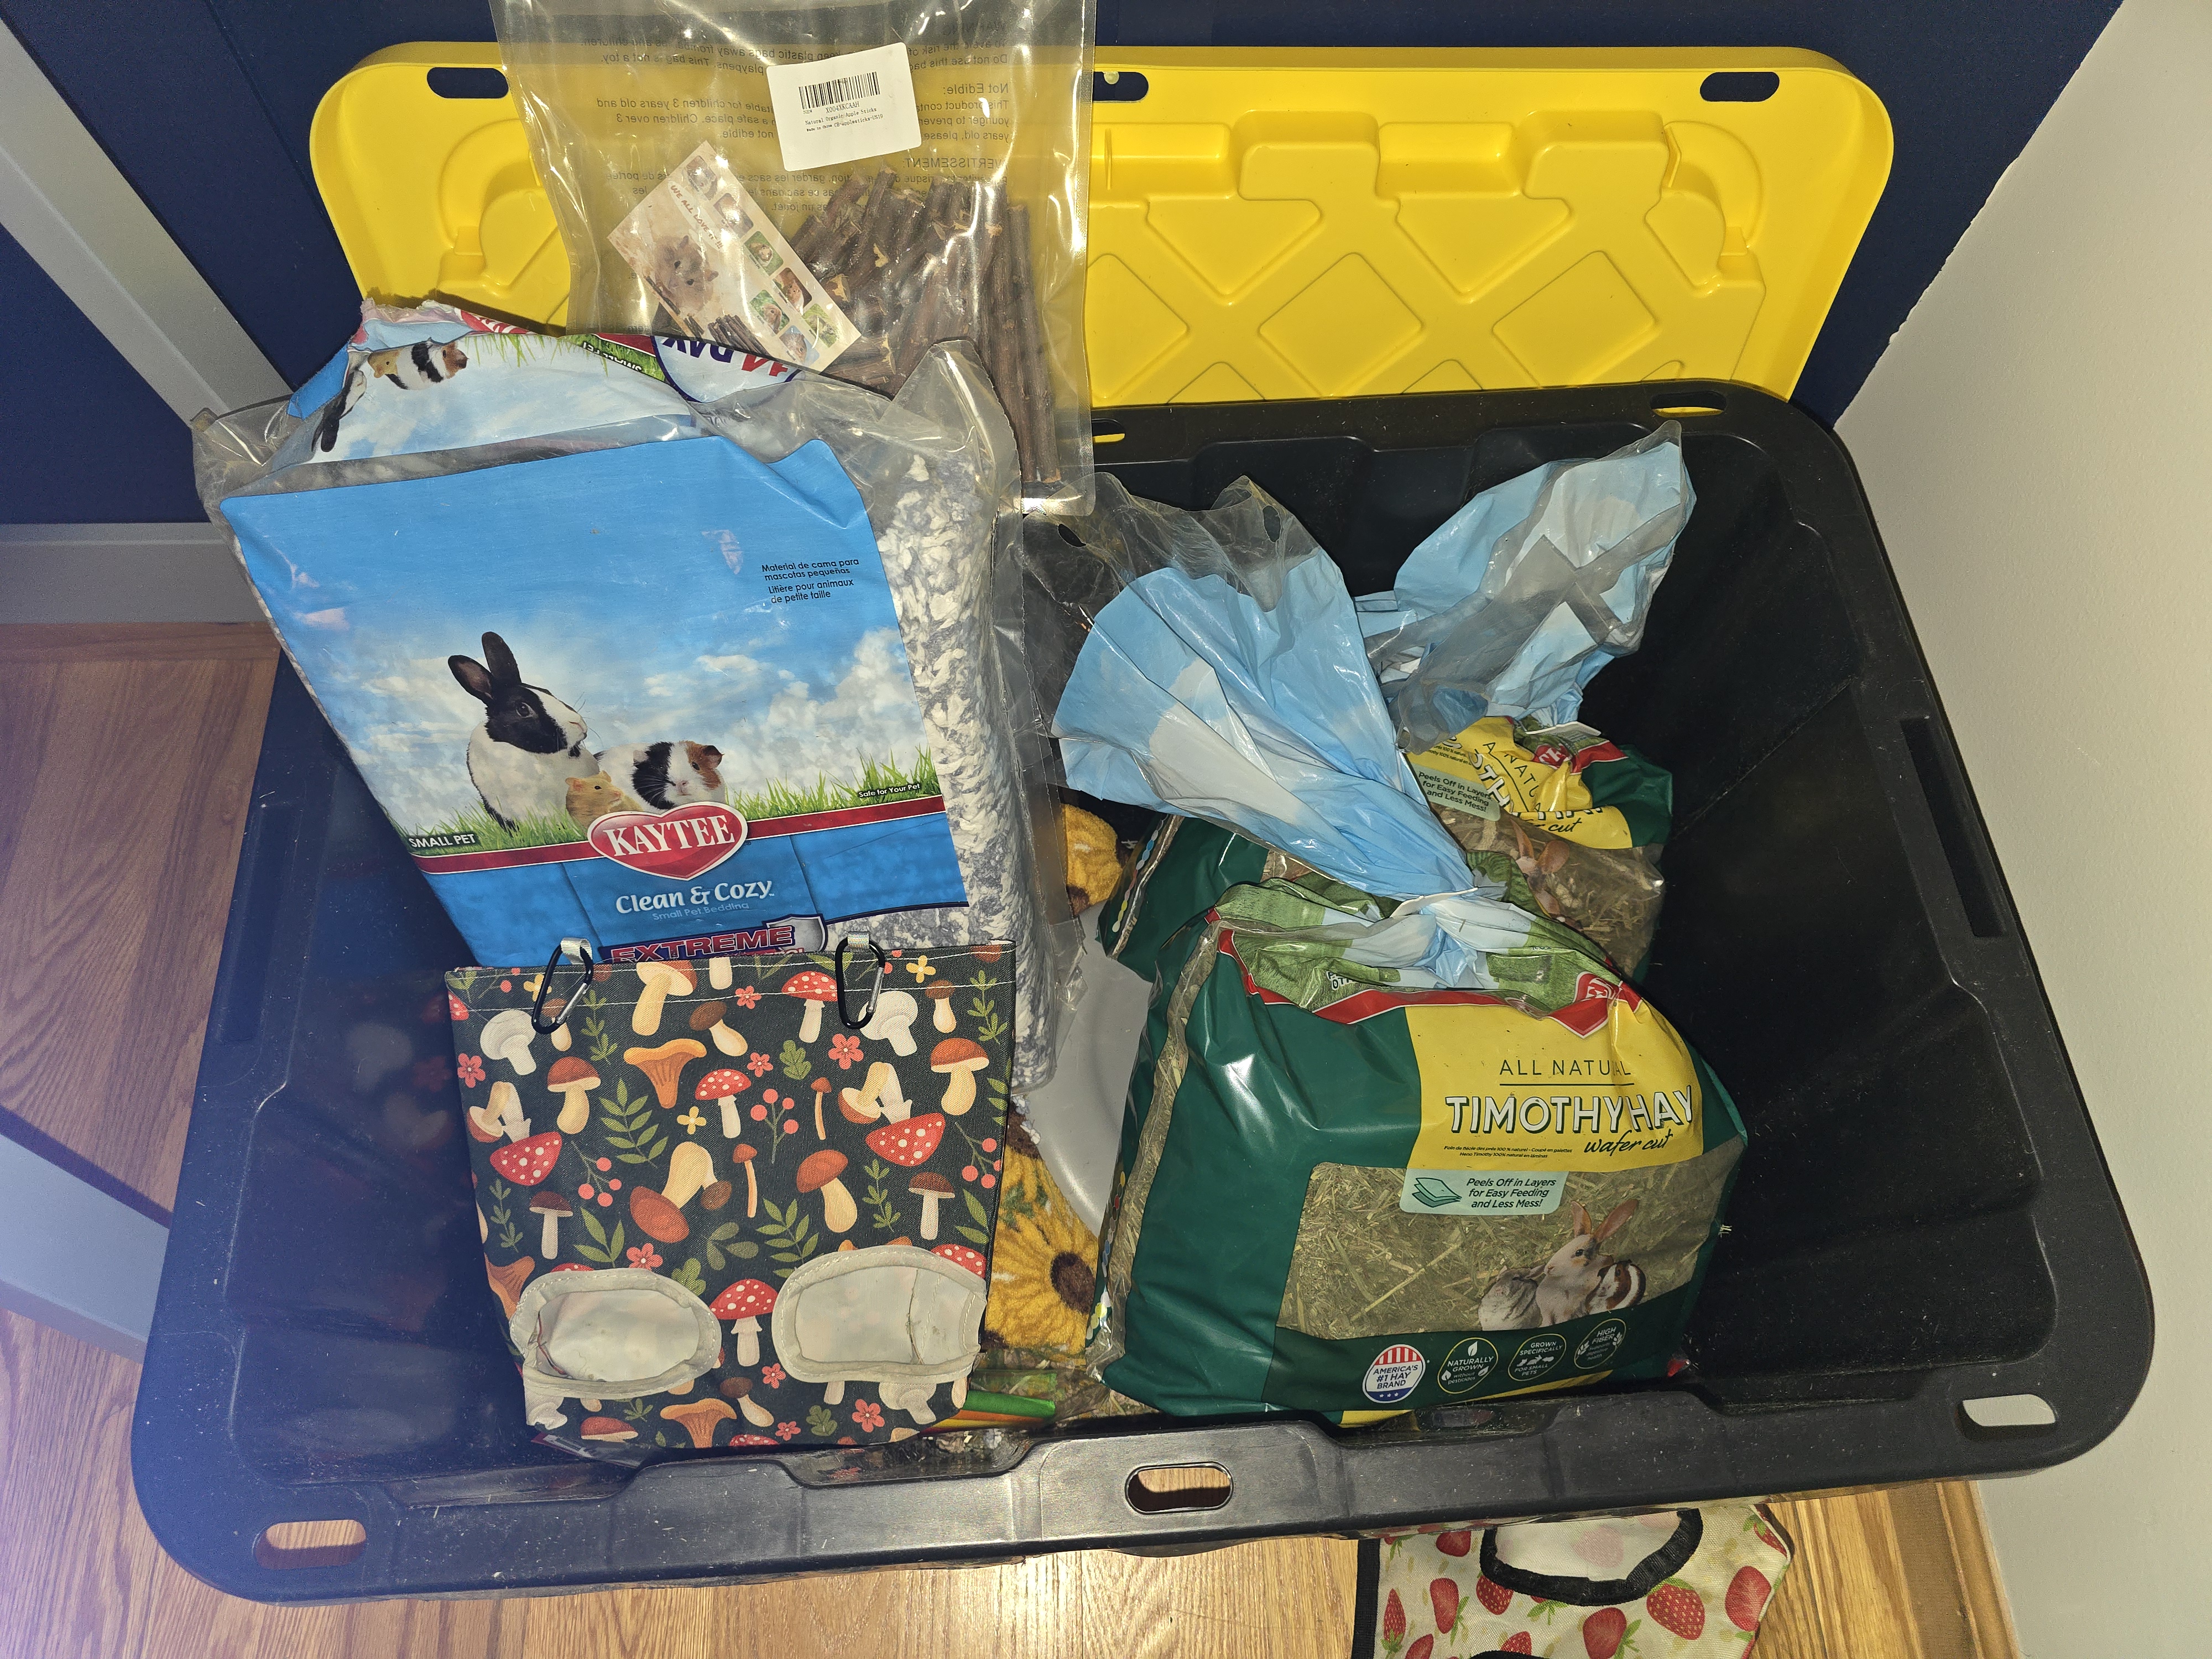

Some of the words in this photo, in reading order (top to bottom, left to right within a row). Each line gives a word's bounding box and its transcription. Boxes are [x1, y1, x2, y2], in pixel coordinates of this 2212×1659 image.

[825, 113, 843, 122] Organic
[669, 184, 684, 199] WE
[680, 198, 695, 214] ALL
[761, 562, 796, 572] Material
[838, 559, 859, 567] para
[764, 571, 806, 581] mascotas
[807, 568, 851, 578] pequeñas
[768, 585, 794, 594] Litière
[796, 583, 815, 593] pour
[817, 578, 854, 588] animaux
[771, 596, 782, 604] de
[784, 593, 809, 604] petite
[811, 590, 831, 599] taille
[1418, 771, 1441, 782] Peels
[1443, 778, 1457, 787] Off
[1427, 789, 1443, 798] and
[1445, 794, 1463, 804] Less
[1464, 799, 1487, 812] Mess!
[1437, 784, 1456, 795] Easy
[1457, 790, 1489, 806] Feeding
[1548, 817, 1583, 832] cut
[409, 836, 453, 848] SMALL
[453, 833, 476, 844] PET
[603, 815, 735, 857] KAYTEE
[615, 891, 686, 914] Clean
[690, 886, 711, 905] &
[714, 880, 773, 901] Cozy
[652, 909, 683, 921] Small
[684, 907, 702, 916] Pet
[703, 902, 750, 914] Bedding
[610, 926, 794, 963] EXTREME
[1499, 1060, 1542, 1076] ALL
[1444, 1095, 1624, 1134] TIMOTHY
[1625, 1084, 1693, 1133] HAY
[1584, 1129, 1643, 1156] wafer
[1642, 1128, 1673, 1150] cut
[1467, 1178, 1494, 1187] Peels
[1496, 1178, 1514, 1187] Off
[1514, 1178, 1523, 1187] in
[1524, 1178, 1557, 1187] Layers
[1469, 1188, 1485, 1197] for
[1485, 1189, 1510, 1198] Easy
[1510, 1188, 1550, 1198] Feeding
[1471, 1199, 1492, 1208] and
[1516, 1199, 1543, 1208] Mess!
[1592, 1333, 1615, 1344] FIBER
[1597, 1326, 1617, 1338] HIGH
[1519, 1345, 1563, 1356] SPECIFICALLY
[1447, 1356, 1494, 1367] NATURALLY
[1452, 1364, 1484, 1373] GROWN
[1373, 1364, 1419, 1375] AMERICA'S
[1376, 1374, 1389, 1383] #1
[1390, 1372, 1411, 1381] HAY
[1377, 1380, 1406, 1389] BRAND
